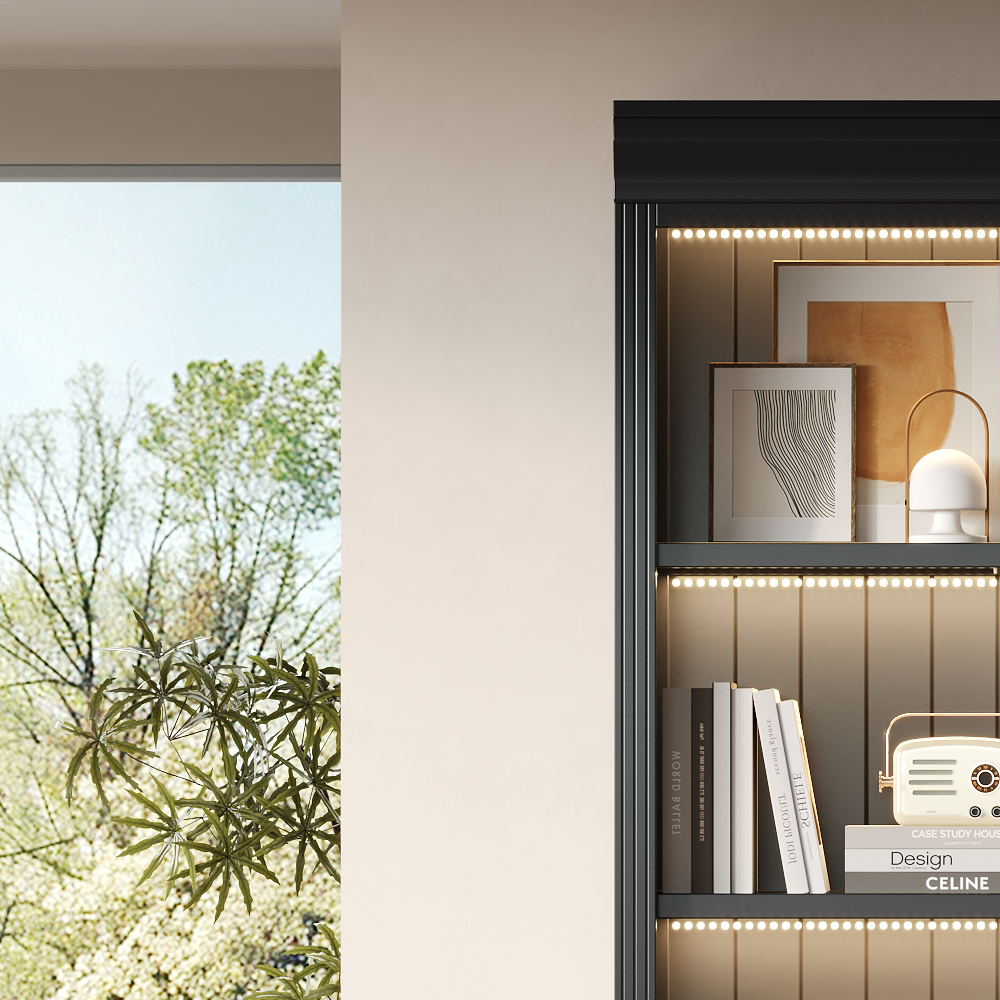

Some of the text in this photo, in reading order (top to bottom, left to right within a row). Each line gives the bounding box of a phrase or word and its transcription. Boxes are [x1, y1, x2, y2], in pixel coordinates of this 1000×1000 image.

[912, 829, 937, 838] CASE
[940, 829, 971, 838] STUDY
[891, 851, 952, 870] Design
[925, 876, 989, 890] CELINE
